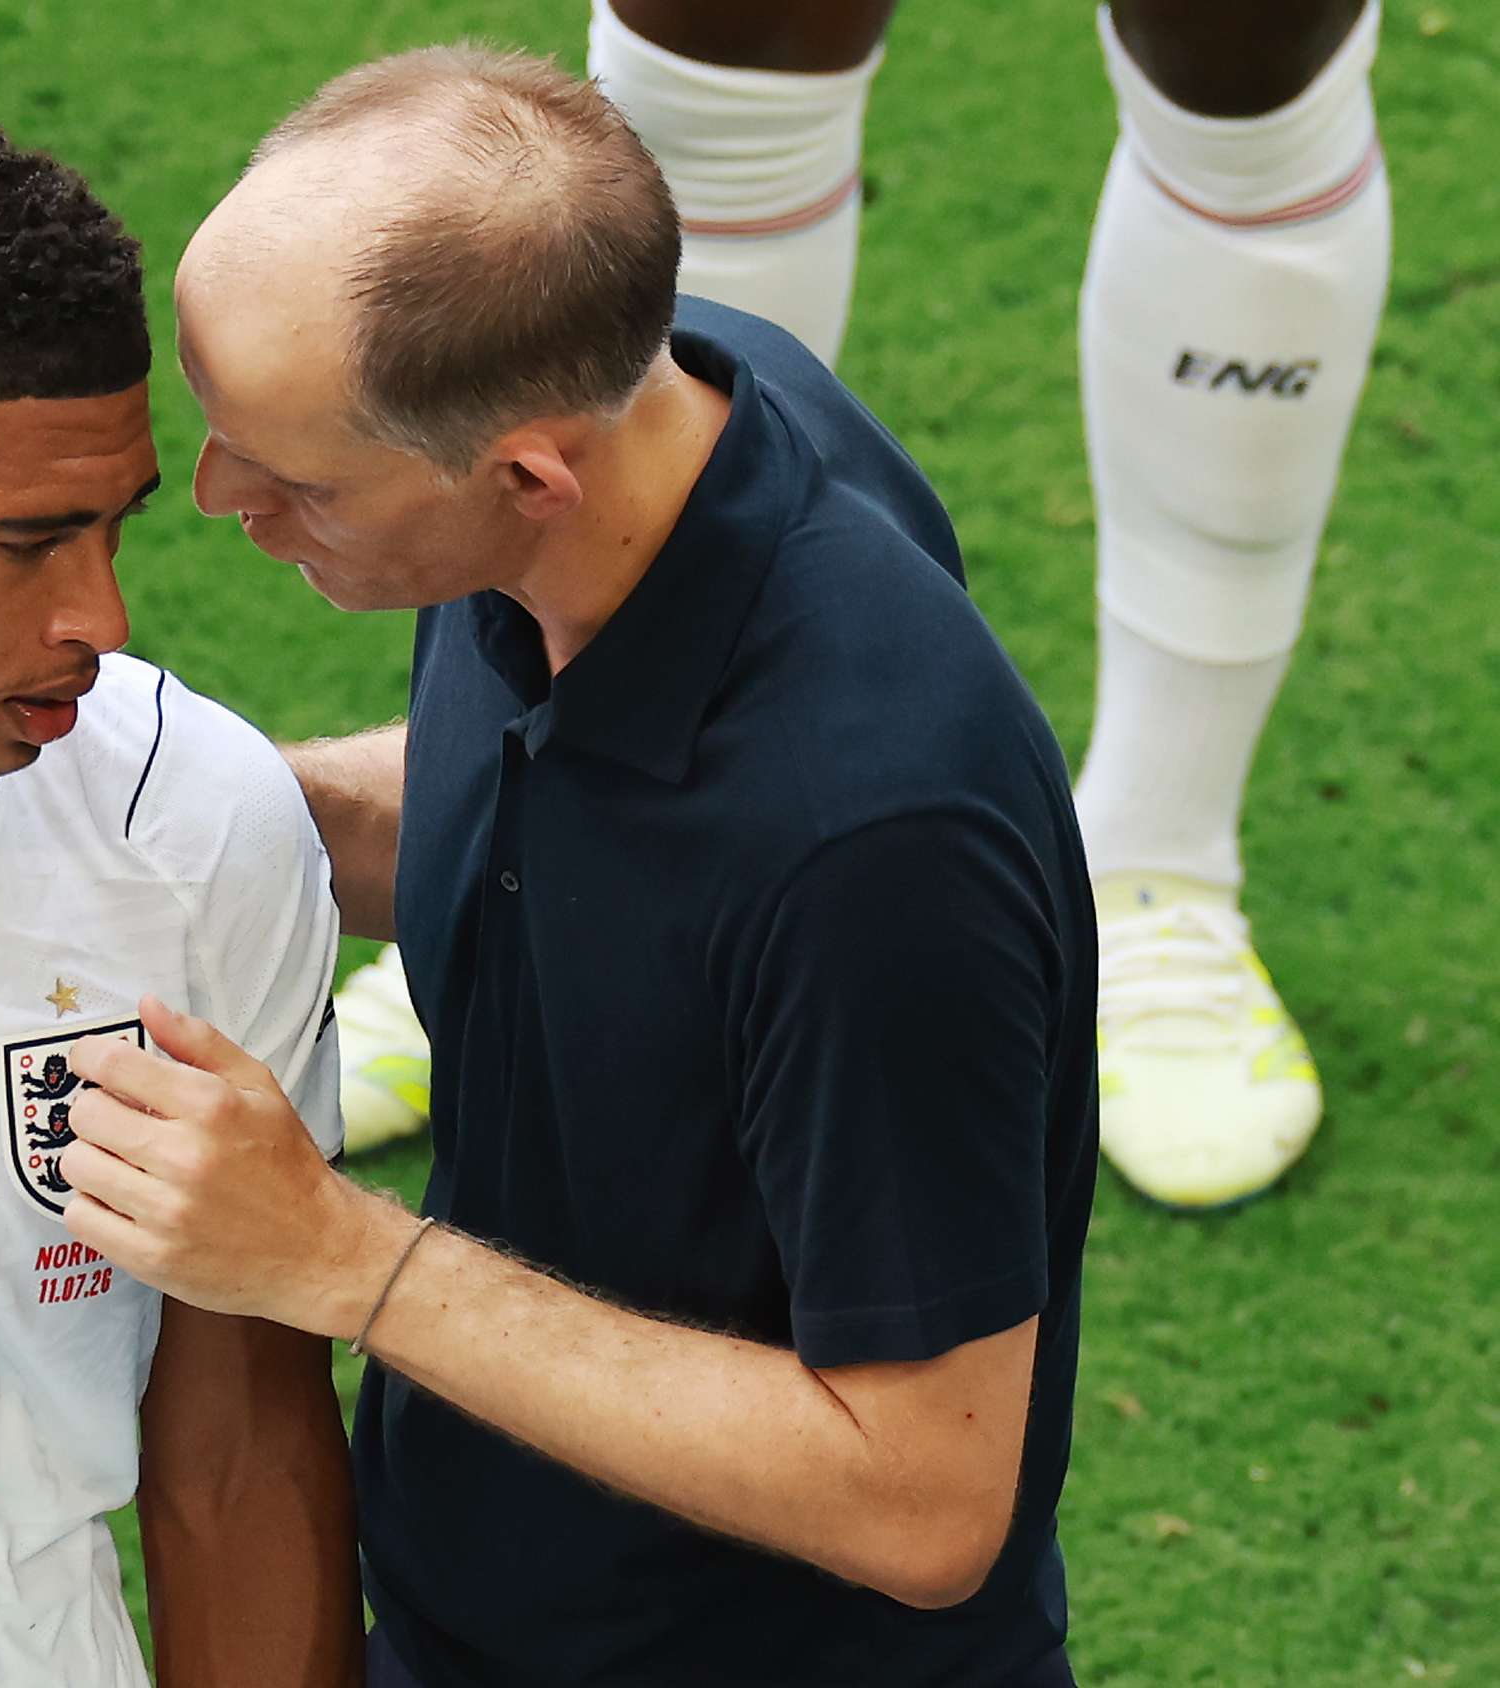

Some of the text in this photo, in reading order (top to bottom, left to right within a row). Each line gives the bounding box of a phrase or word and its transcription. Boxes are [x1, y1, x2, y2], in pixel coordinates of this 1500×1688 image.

[1174, 351, 1322, 398] ENG
[35, 1241, 104, 1271] NORW
[39, 1267, 112, 1304] 11.07.26
